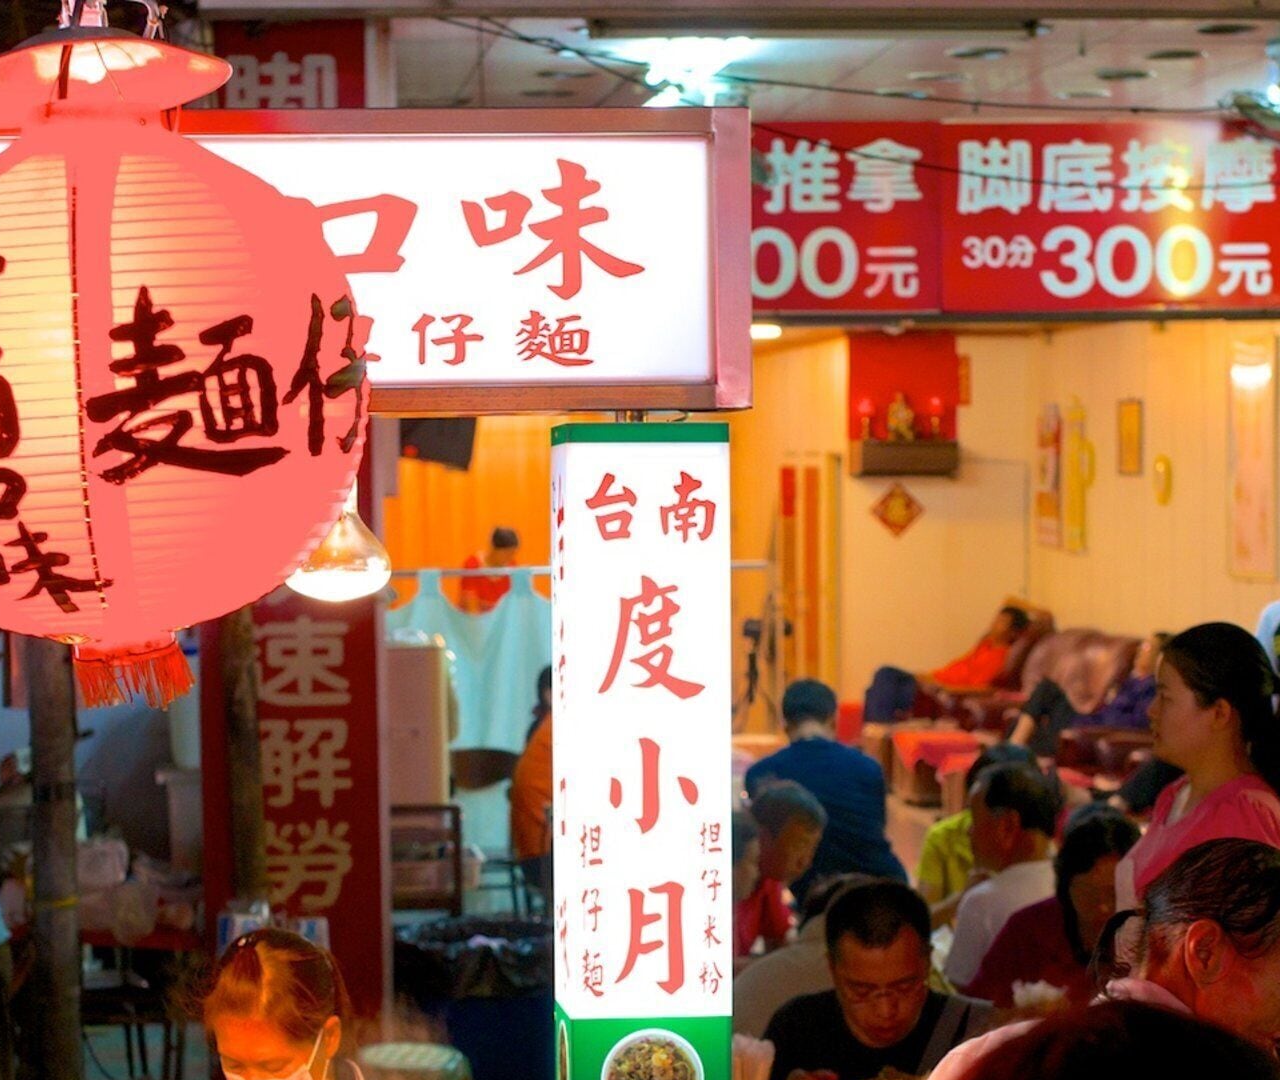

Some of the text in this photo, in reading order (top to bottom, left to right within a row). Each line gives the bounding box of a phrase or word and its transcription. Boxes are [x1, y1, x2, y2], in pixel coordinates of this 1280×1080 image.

[763, 138, 923, 214] 推拿
[285, 158, 645, 300] 口味
[961, 223, 1272, 299] 30分 300元
[585, 471, 717, 543] 台南
[597, 575, 706, 995] 度小月
